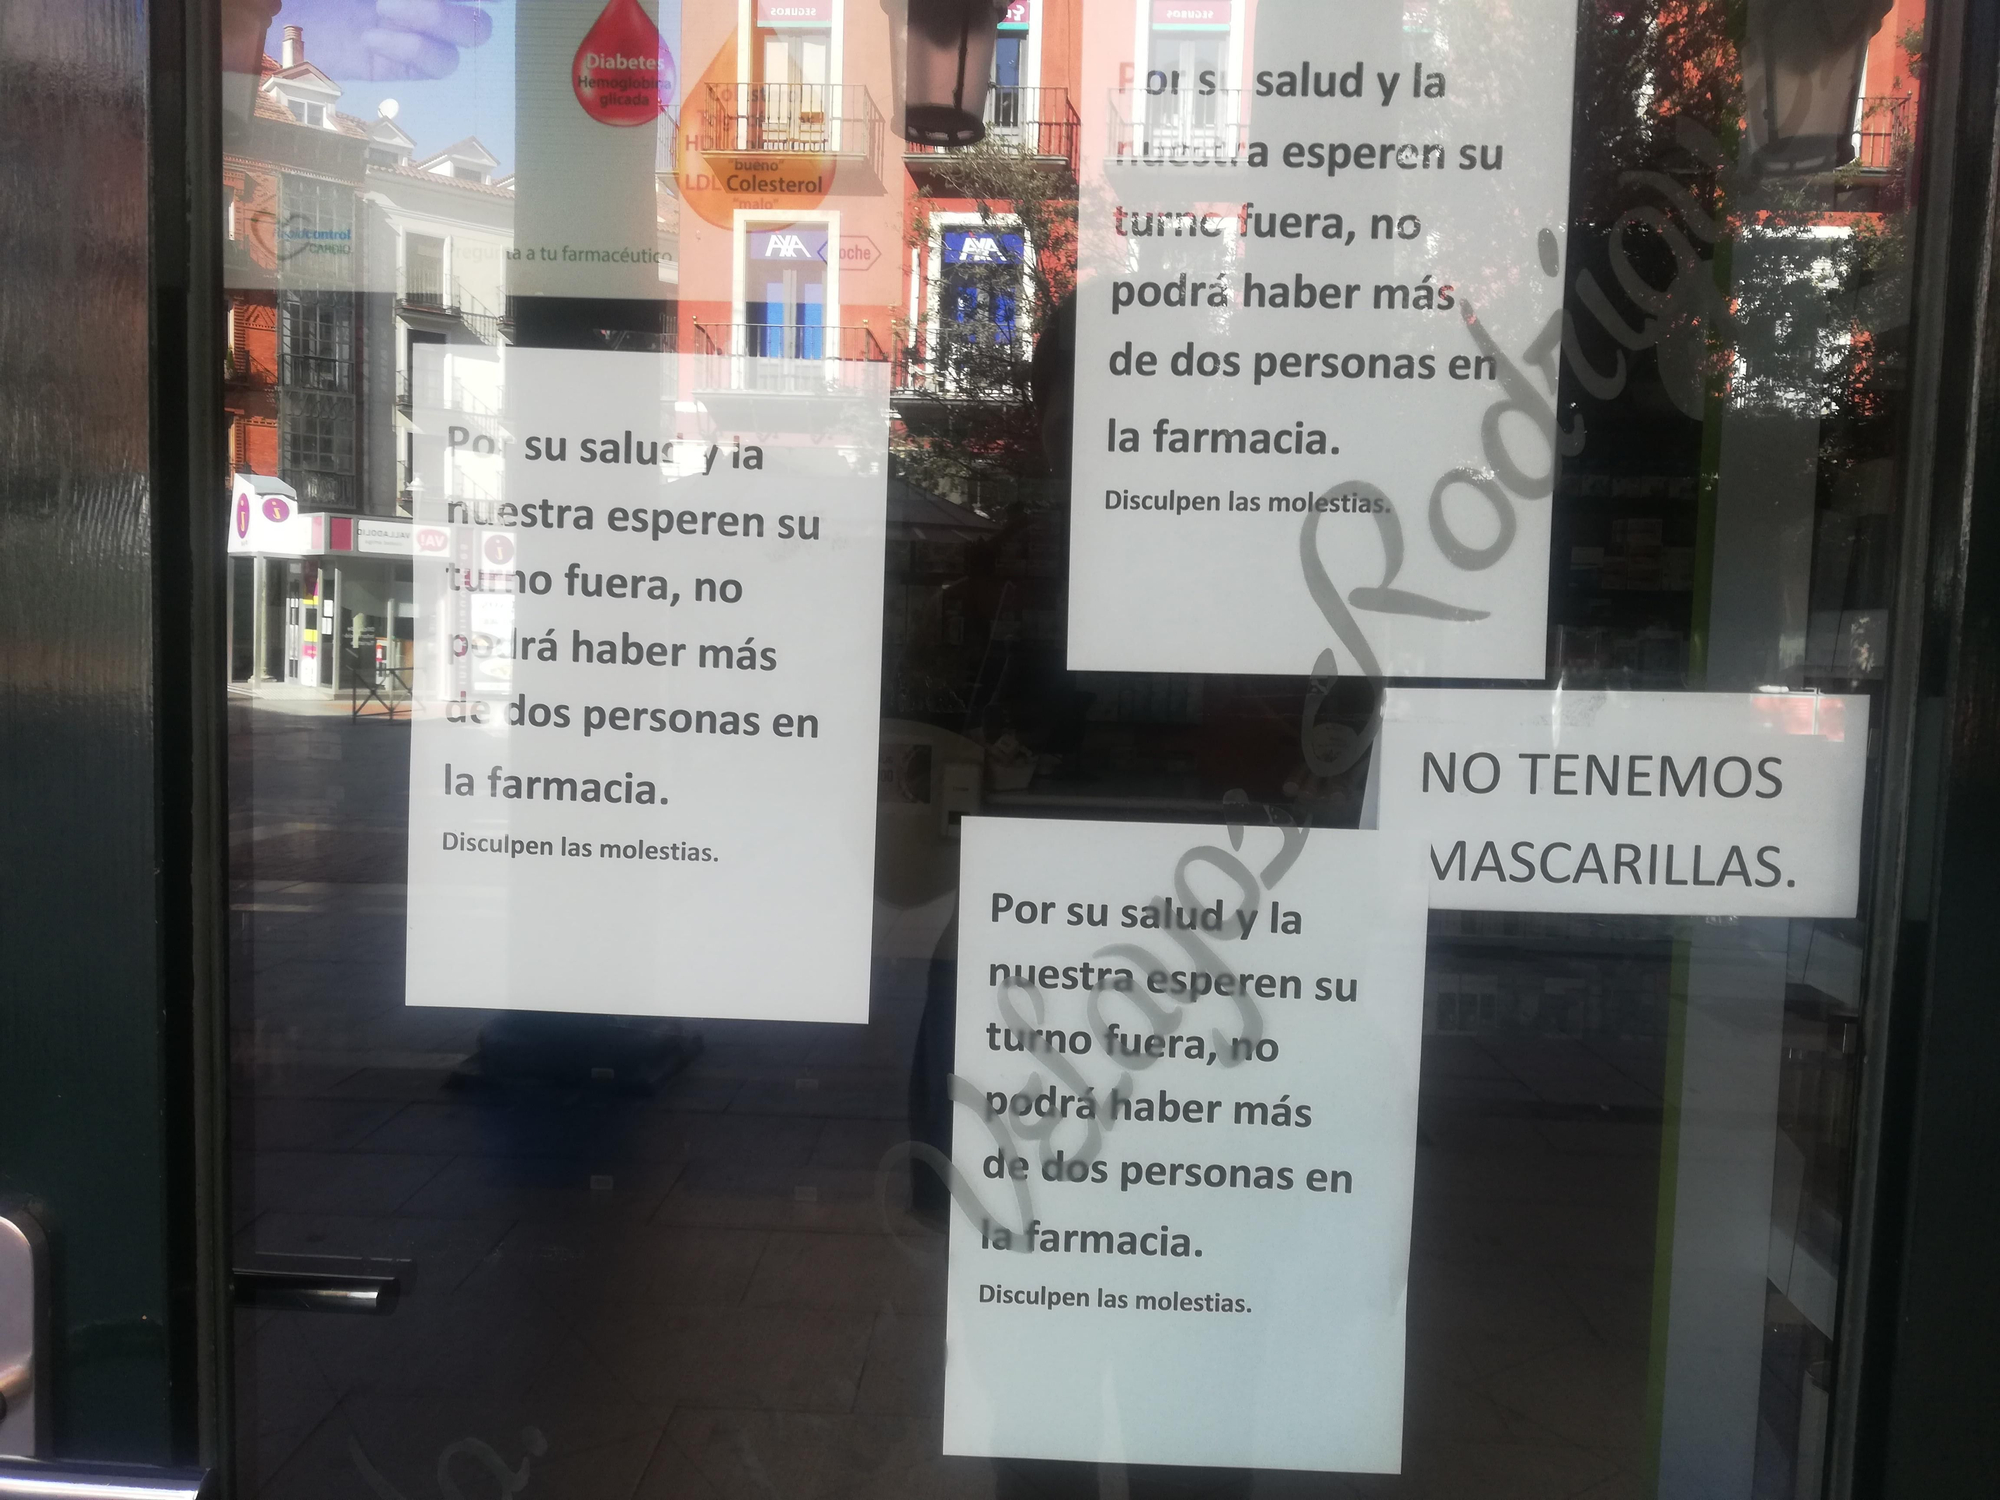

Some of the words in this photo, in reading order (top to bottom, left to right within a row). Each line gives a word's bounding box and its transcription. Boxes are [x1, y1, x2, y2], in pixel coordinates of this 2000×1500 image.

[585, 52, 666, 71] Diabetes
[599, 92, 650, 108] glicada
[1255, 61, 1364, 97] salud
[1377, 73, 1400, 106] y
[1413, 61, 1447, 98] la
[1282, 141, 1446, 177] esperen
[1458, 144, 1503, 171] su
[685, 173, 721, 191] LDL
[726, 174, 823, 193] Colesterol
[1113, 205, 1223, 237] turno
[1237, 202, 1357, 246] fuera,
[1370, 212, 1421, 240] no
[525, 248, 535, 260] a
[540, 246, 557, 261] tu
[562, 245, 673, 264] farmacéutico
[839, 244, 871, 260] oche
[1111, 272, 1229, 315] podrá
[1243, 272, 1361, 310] haber
[1373, 274, 1456, 311] más
[1109, 341, 1157, 376] de
[1170, 341, 1240, 377] dos
[1254, 350, 1436, 385] personas
[1448, 353, 1497, 381] en
[448, 425, 504, 460] Po
[524, 435, 567, 462] su
[732, 435, 764, 470] la
[1107, 418, 1139, 453] la
[1153, 418, 1341, 455] farmacia.
[447, 499, 594, 531] nuestra
[607, 504, 765, 541] esperen
[778, 514, 820, 540] su
[1105, 489, 1221, 515] Disculpen
[1229, 491, 1261, 512] las
[1268, 491, 1392, 513] molestias.
[446, 562, 552, 595] turno
[565, 562, 680, 606] fuera,
[695, 577, 743, 604] no
[571, 629, 686, 667] haber
[699, 637, 777, 671] más
[445, 691, 491, 725] de
[504, 693, 571, 728] dos
[584, 704, 760, 736] personas
[773, 712, 819, 738] en
[444, 763, 475, 796] la
[488, 765, 669, 805] farmacia.
[1422, 751, 1500, 794] NO
[1518, 753, 1783, 799] TENEMOS
[442, 831, 553, 858] Disculpen
[560, 837, 593, 858] las
[600, 839, 719, 863] molestias.
[1430, 840, 1796, 888] MASCARILLAS.
[990, 893, 1056, 925] Por
[1066, 902, 1108, 927] su
[1121, 897, 1223, 931] salud
[1237, 909, 1258, 940] y
[1270, 901, 1302, 935] la
[989, 961, 1134, 992] nuestra
[1147, 969, 1301, 1002] esperen
[1315, 976, 1358, 1002] su
[986, 1022, 1092, 1055] turno
[1104, 1023, 1217, 1066] fuera,
[1231, 1035, 1279, 1063] no
[984, 1085, 1096, 1122] podrá
[1109, 1088, 1222, 1123] haber
[1233, 1095, 1312, 1128] más
[983, 1148, 1030, 1181] de
[1042, 1150, 1108, 1183] dos
[1120, 1160, 1294, 1191] personas
[1306, 1167, 1353, 1193] en
[981, 1219, 1012, 1250] la
[1027, 1220, 1203, 1258] farmacia.
[979, 1284, 1090, 1310] Disculpen
[1097, 1288, 1128, 1309] las
[1135, 1291, 1252, 1313] molestias.
